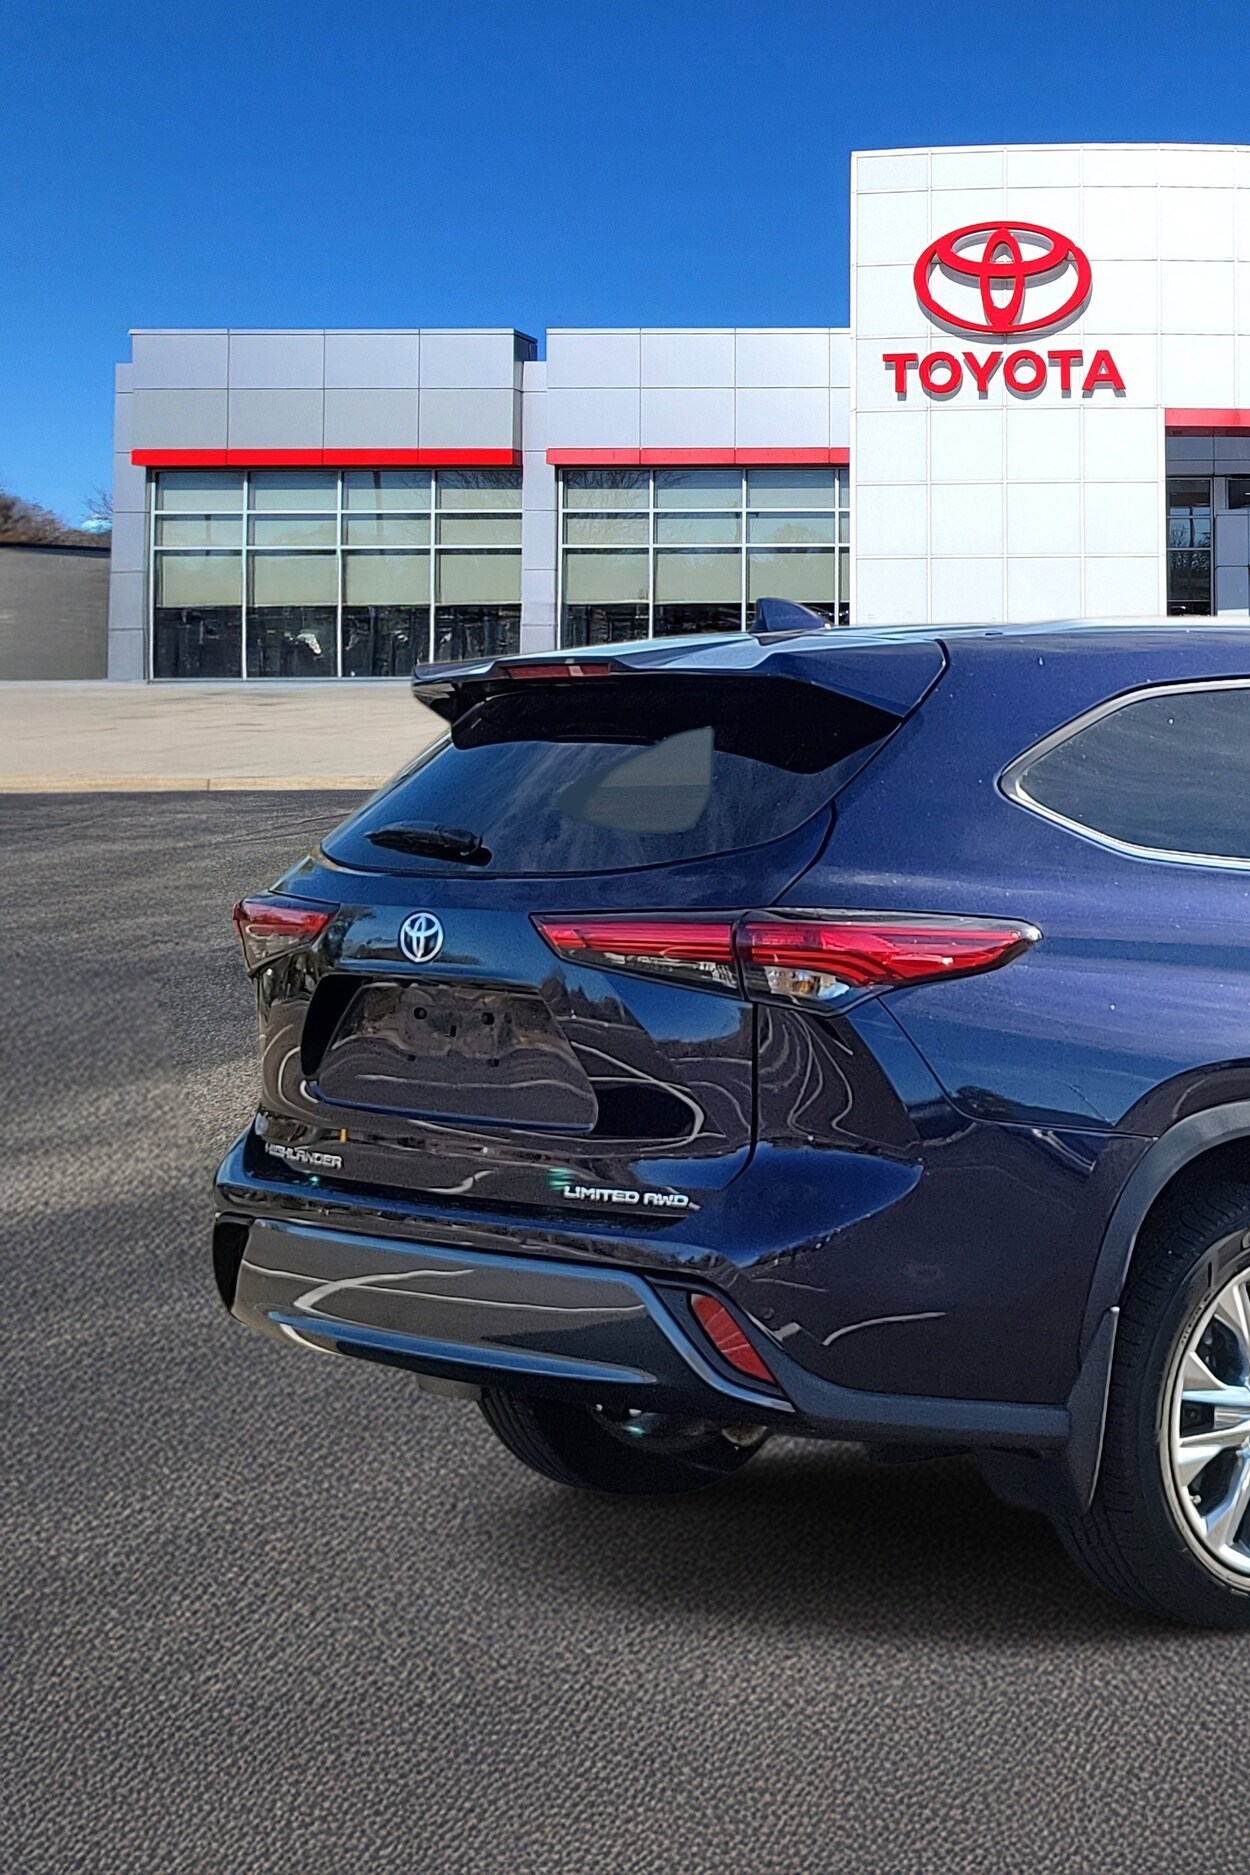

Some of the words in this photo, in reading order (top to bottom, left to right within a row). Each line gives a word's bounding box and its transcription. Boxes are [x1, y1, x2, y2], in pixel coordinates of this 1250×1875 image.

[882, 350, 1126, 397] TOYOTA
[563, 1185, 640, 1205] LIMITED
[643, 1192, 689, 1208] AWD
